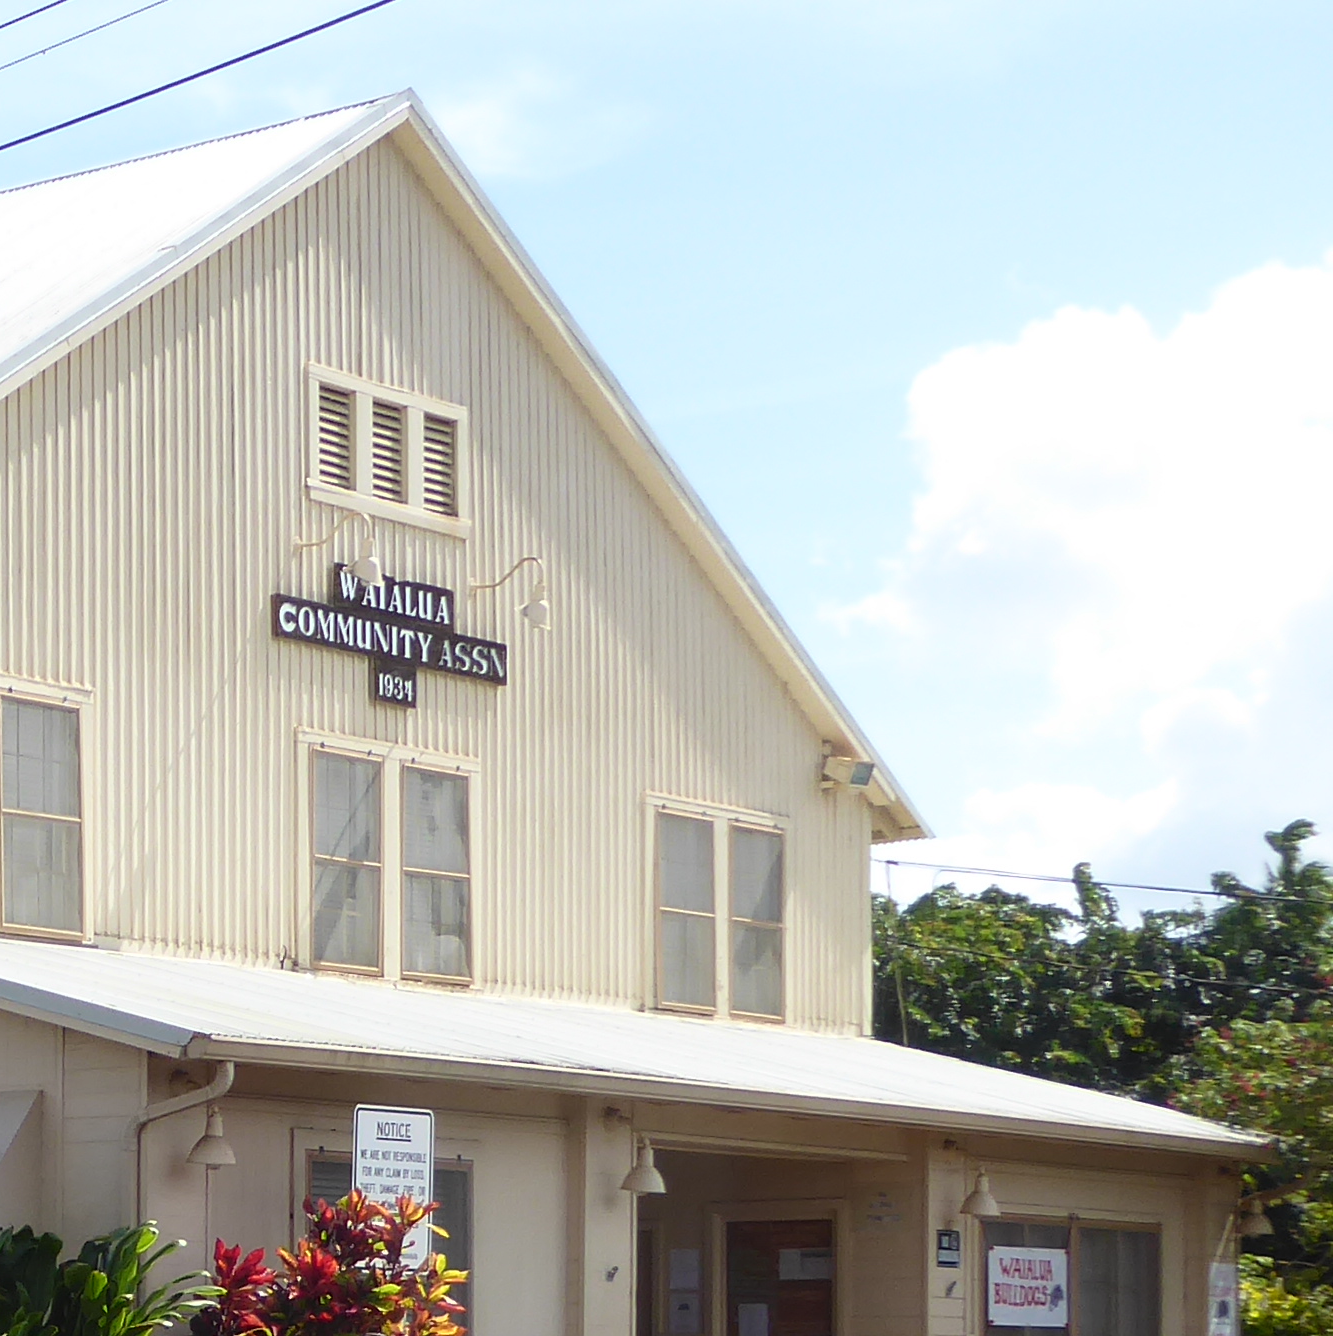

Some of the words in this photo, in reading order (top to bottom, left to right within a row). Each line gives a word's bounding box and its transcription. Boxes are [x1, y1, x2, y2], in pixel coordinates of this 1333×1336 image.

[339, 570, 451, 626] WAIALUA
[279, 602, 434, 663] COMMUNITY
[378, 672, 414, 702] 1934
[376, 1121, 412, 1139] NOTICE
[999, 1257, 1053, 1282] WAIALUA
